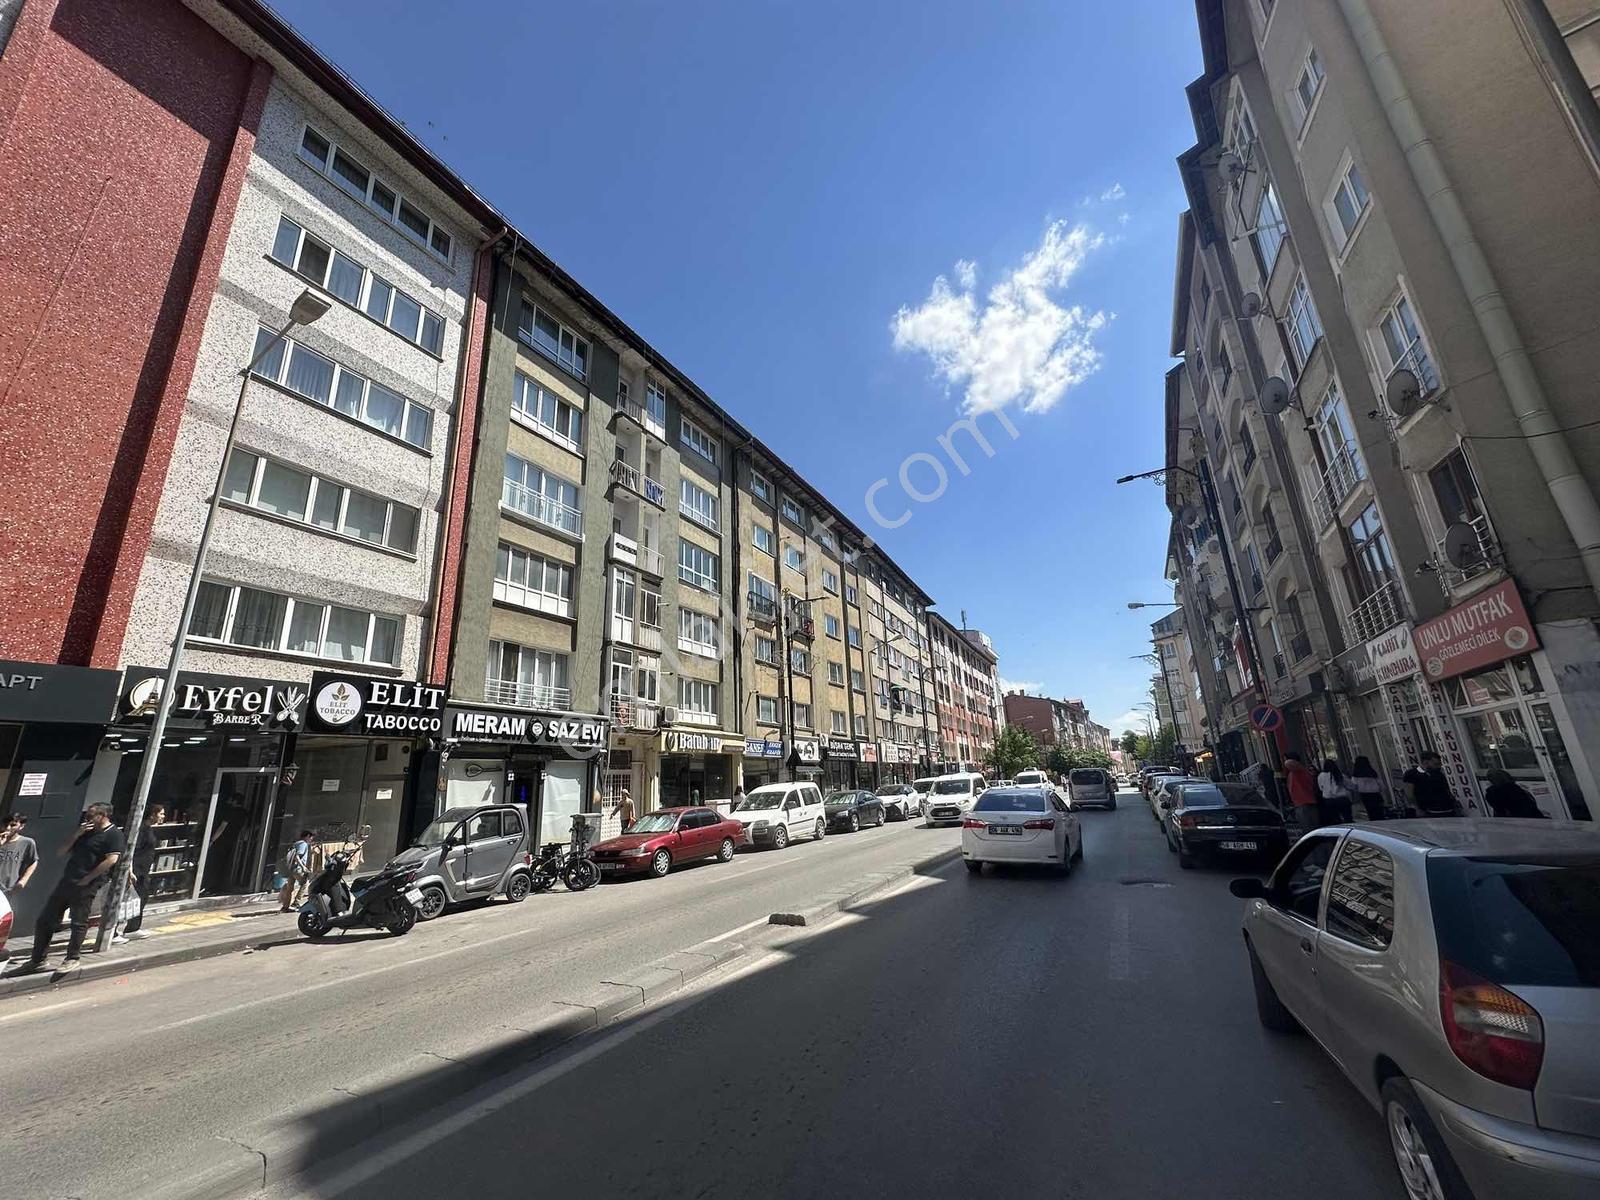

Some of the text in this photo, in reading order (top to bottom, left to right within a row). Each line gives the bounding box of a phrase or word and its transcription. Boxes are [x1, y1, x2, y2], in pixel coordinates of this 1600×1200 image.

[1450, 591, 1513, 637] MUTFAK
[1475, 626, 1502, 647] DİLEK
[366, 681, 445, 710] ELİT
[364, 713, 441, 732] TABOCCO
[456, 712, 526, 737] MERAM
[549, 720, 604, 741] SAZ EVİ
[1429, 682, 1477, 810] AHIT KUNDURA
